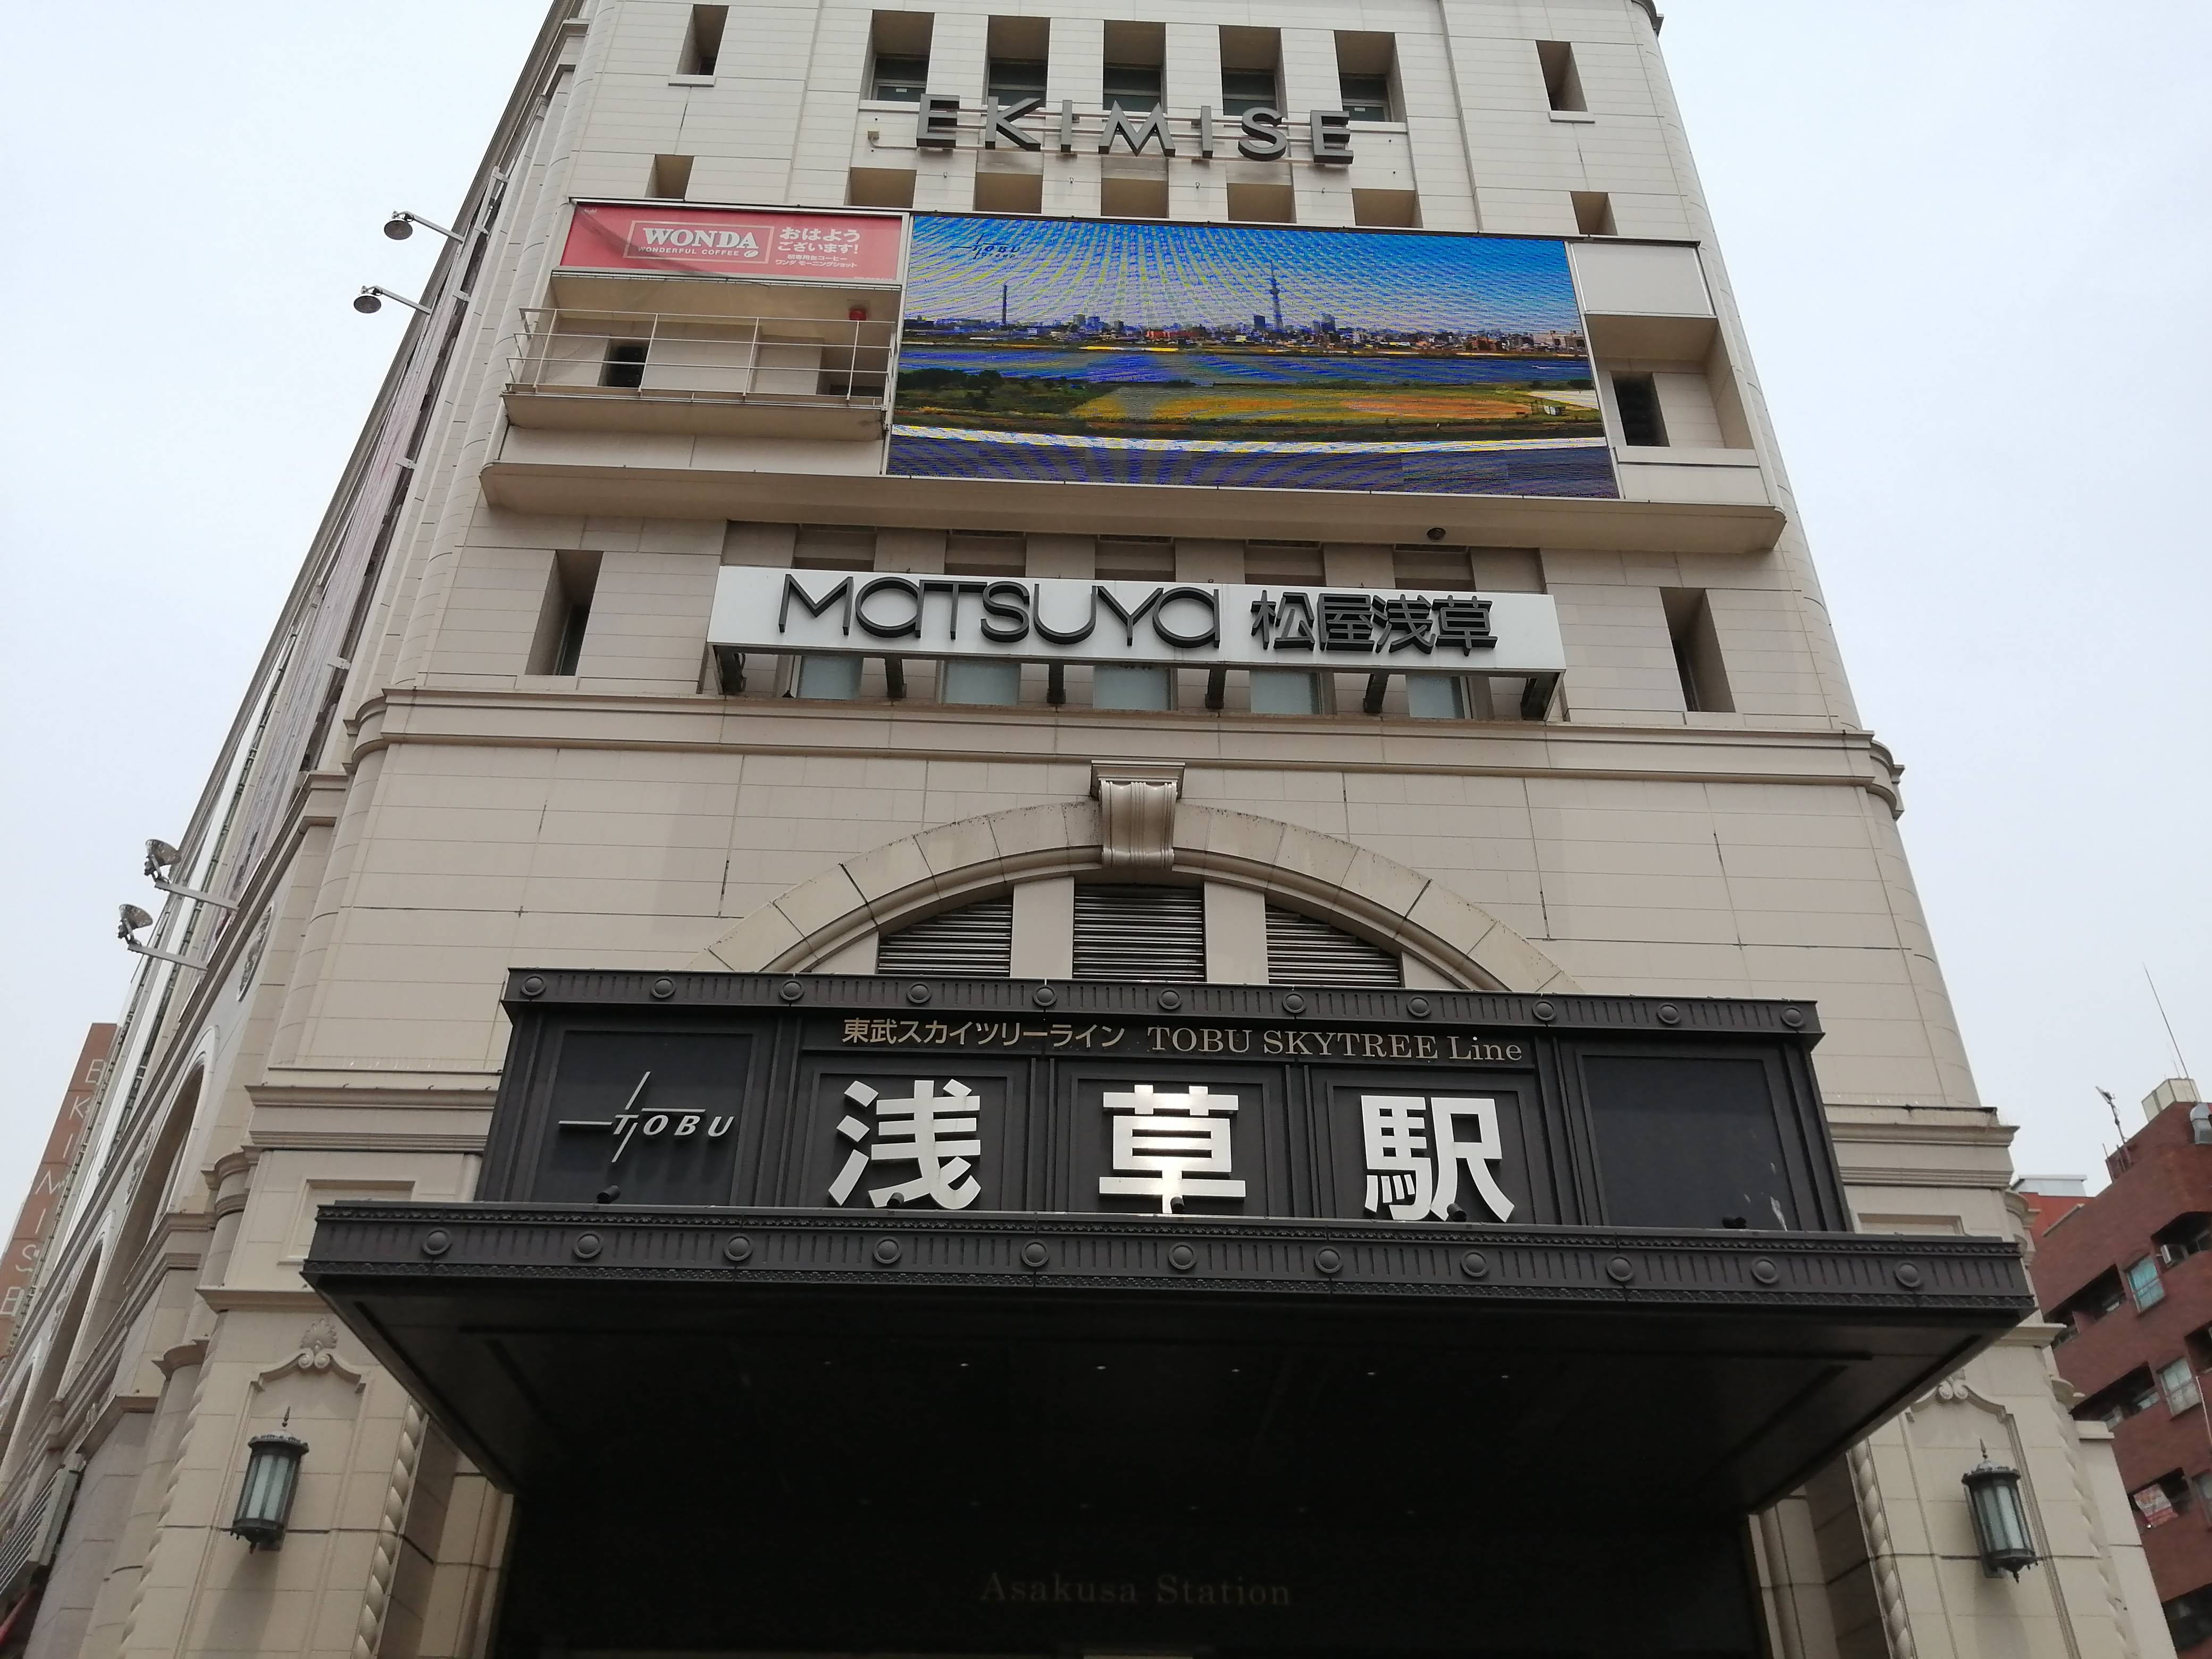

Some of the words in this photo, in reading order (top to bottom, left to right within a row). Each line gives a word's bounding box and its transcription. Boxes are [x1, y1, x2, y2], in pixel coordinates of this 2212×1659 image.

[916, 94, 1354, 164] EKIMISE
[638, 246, 697, 255] WONDERFUL
[643, 228, 759, 249] WONDA
[779, 227, 860, 243] おはよう
[1251, 589, 1498, 656] 松屋浅草
[842, 1017, 1125, 1048] 東武スカイツリーライン
[1147, 1026, 1253, 1054] TOBU
[1263, 1029, 1439, 1060] SKYTREE
[1447, 1035, 1523, 1062] Line
[827, 1079, 1515, 1222] 浅草駅
[979, 1572, 1138, 1603] Asakusa
[1156, 1574, 1292, 1607] Station
